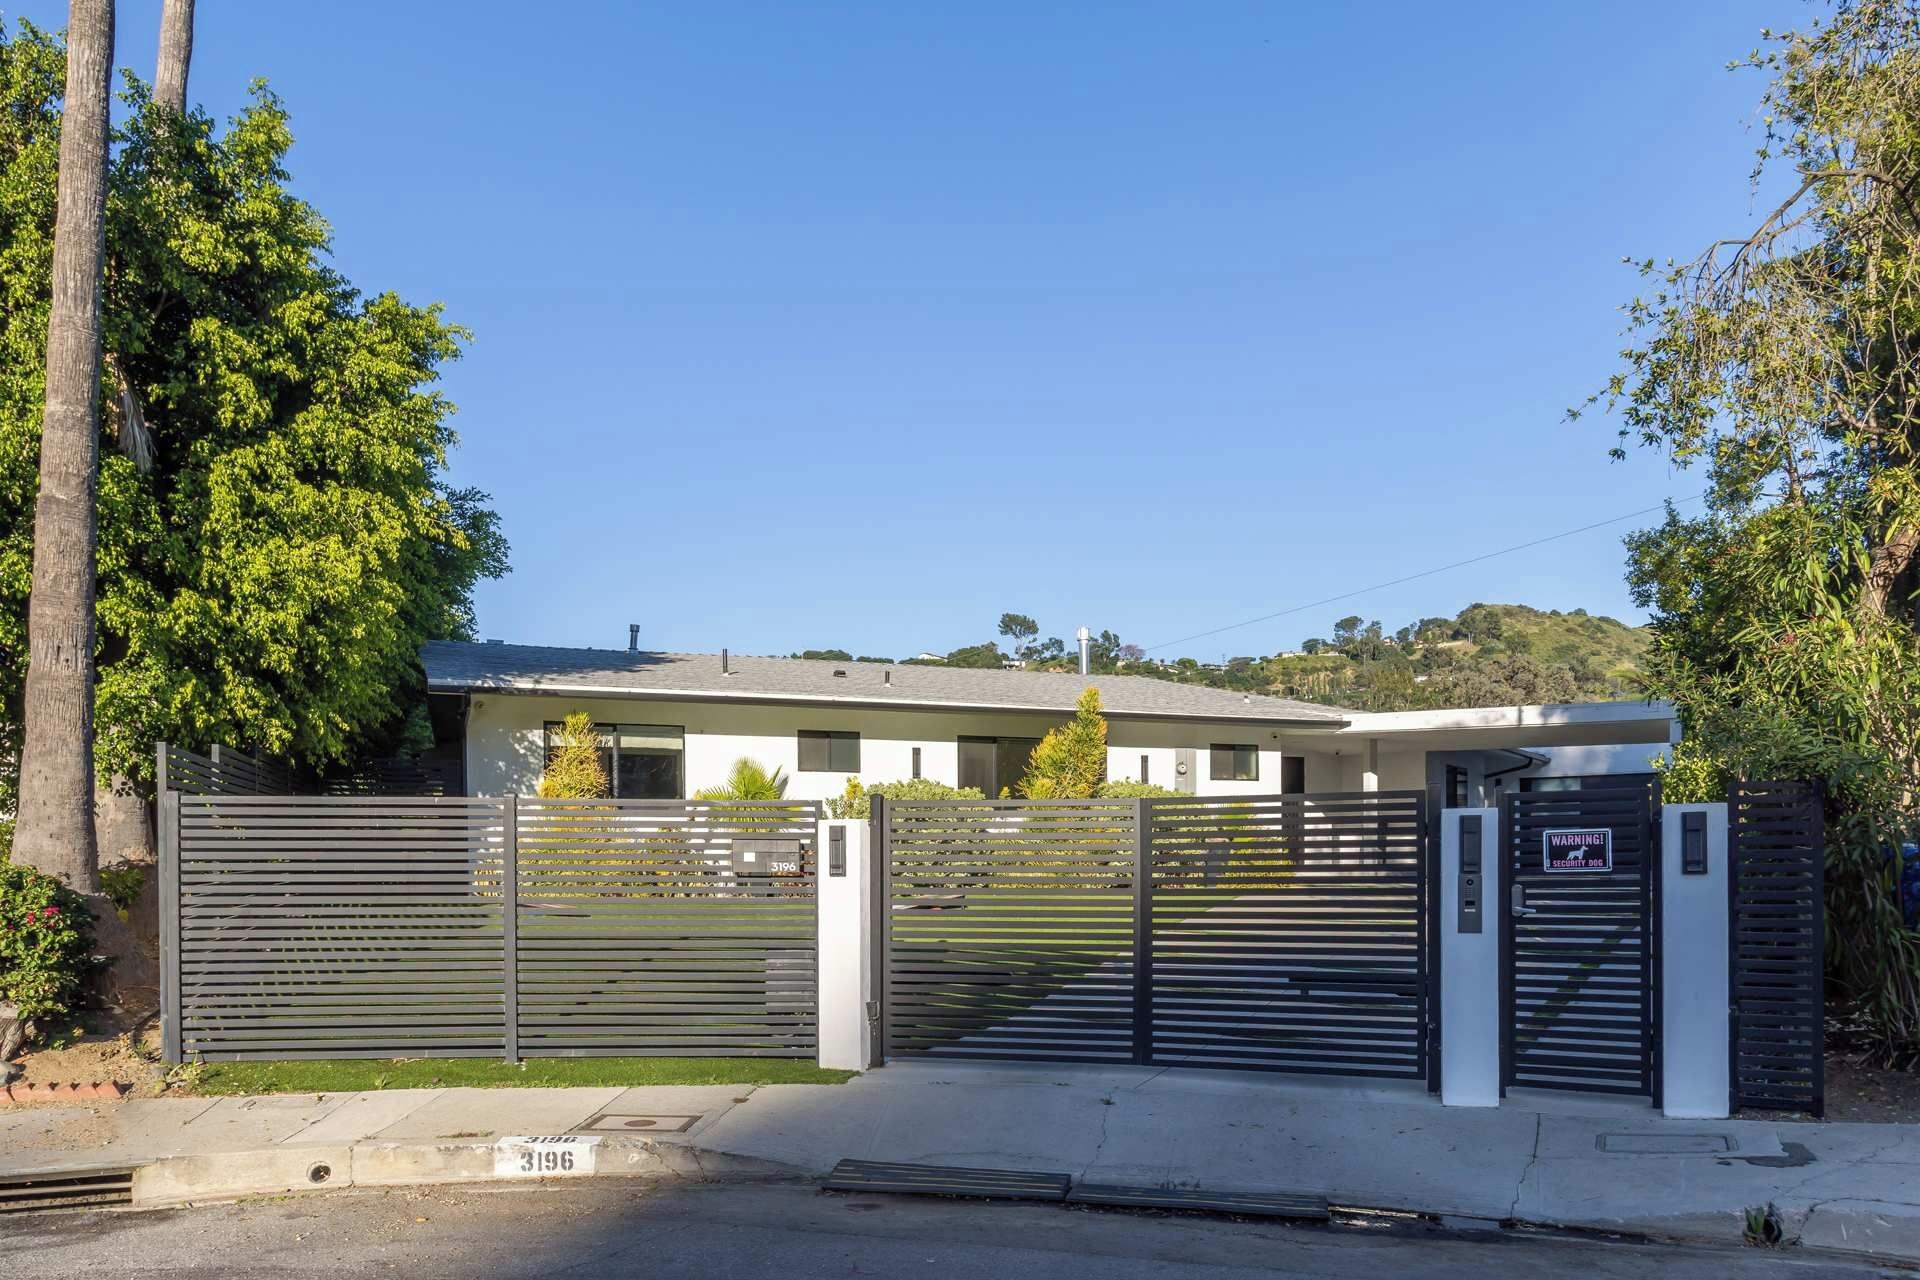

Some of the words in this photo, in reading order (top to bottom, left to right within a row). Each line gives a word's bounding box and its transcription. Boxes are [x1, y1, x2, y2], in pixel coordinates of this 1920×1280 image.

[1551, 834, 1604, 846] WARNING!
[771, 862, 796, 871] 3196
[1552, 859, 1586, 867] SECURITY
[1588, 859, 1603, 867] DOG
[520, 1151, 574, 1172] 3196
